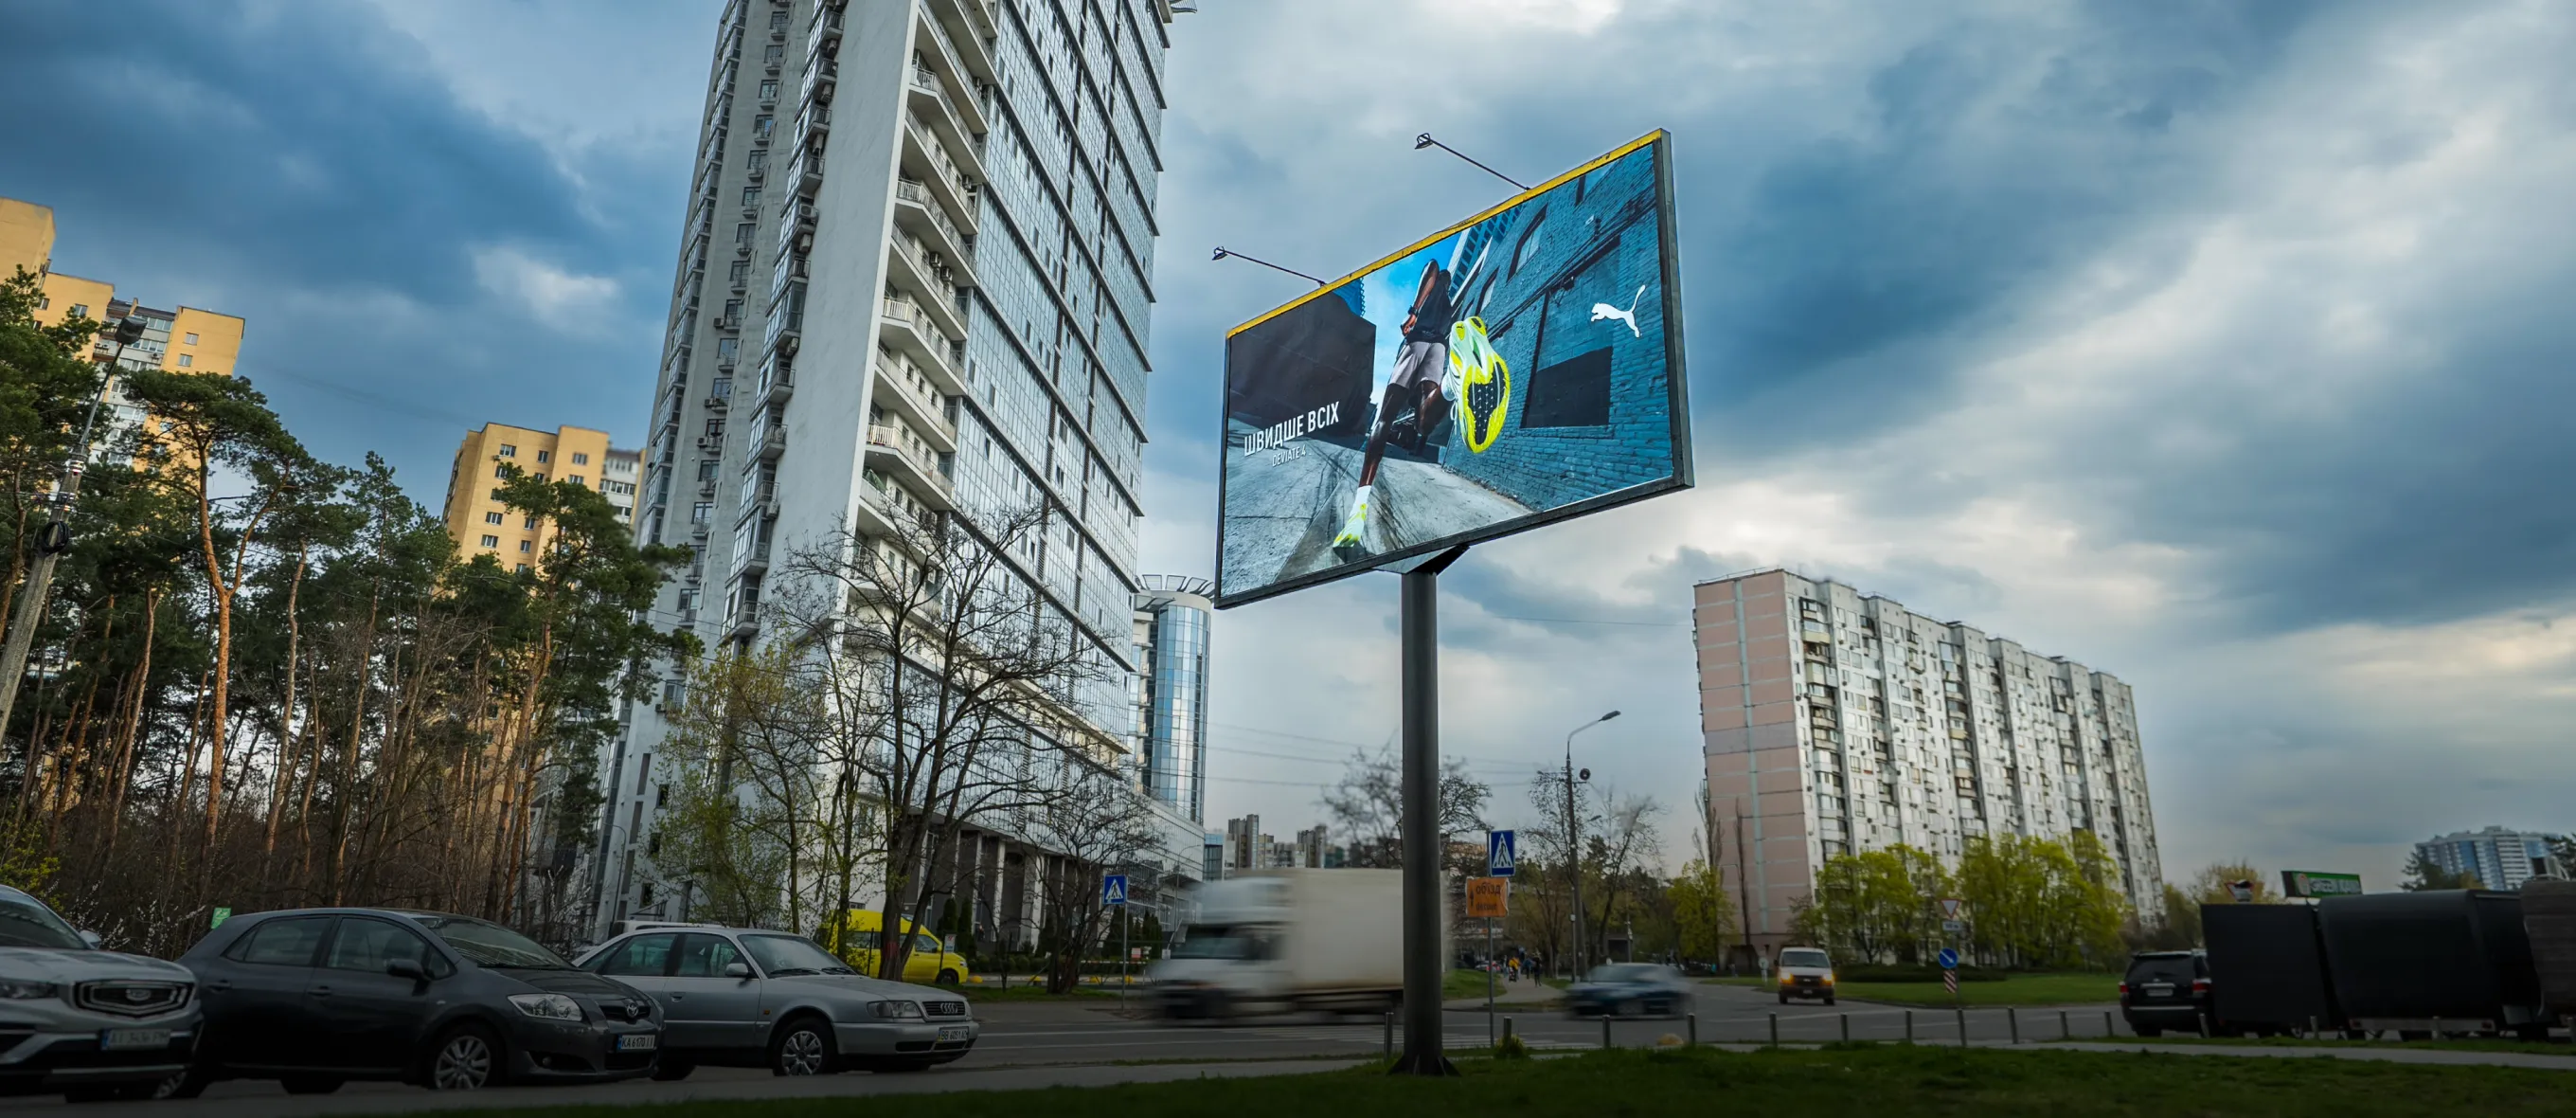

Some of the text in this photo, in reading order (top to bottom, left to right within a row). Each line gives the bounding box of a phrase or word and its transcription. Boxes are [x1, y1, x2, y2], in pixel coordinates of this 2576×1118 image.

[1243, 401, 1340, 457] ШВИДШЕ ВСІХ
[1272, 443, 1307, 467] DEVIATE 4
